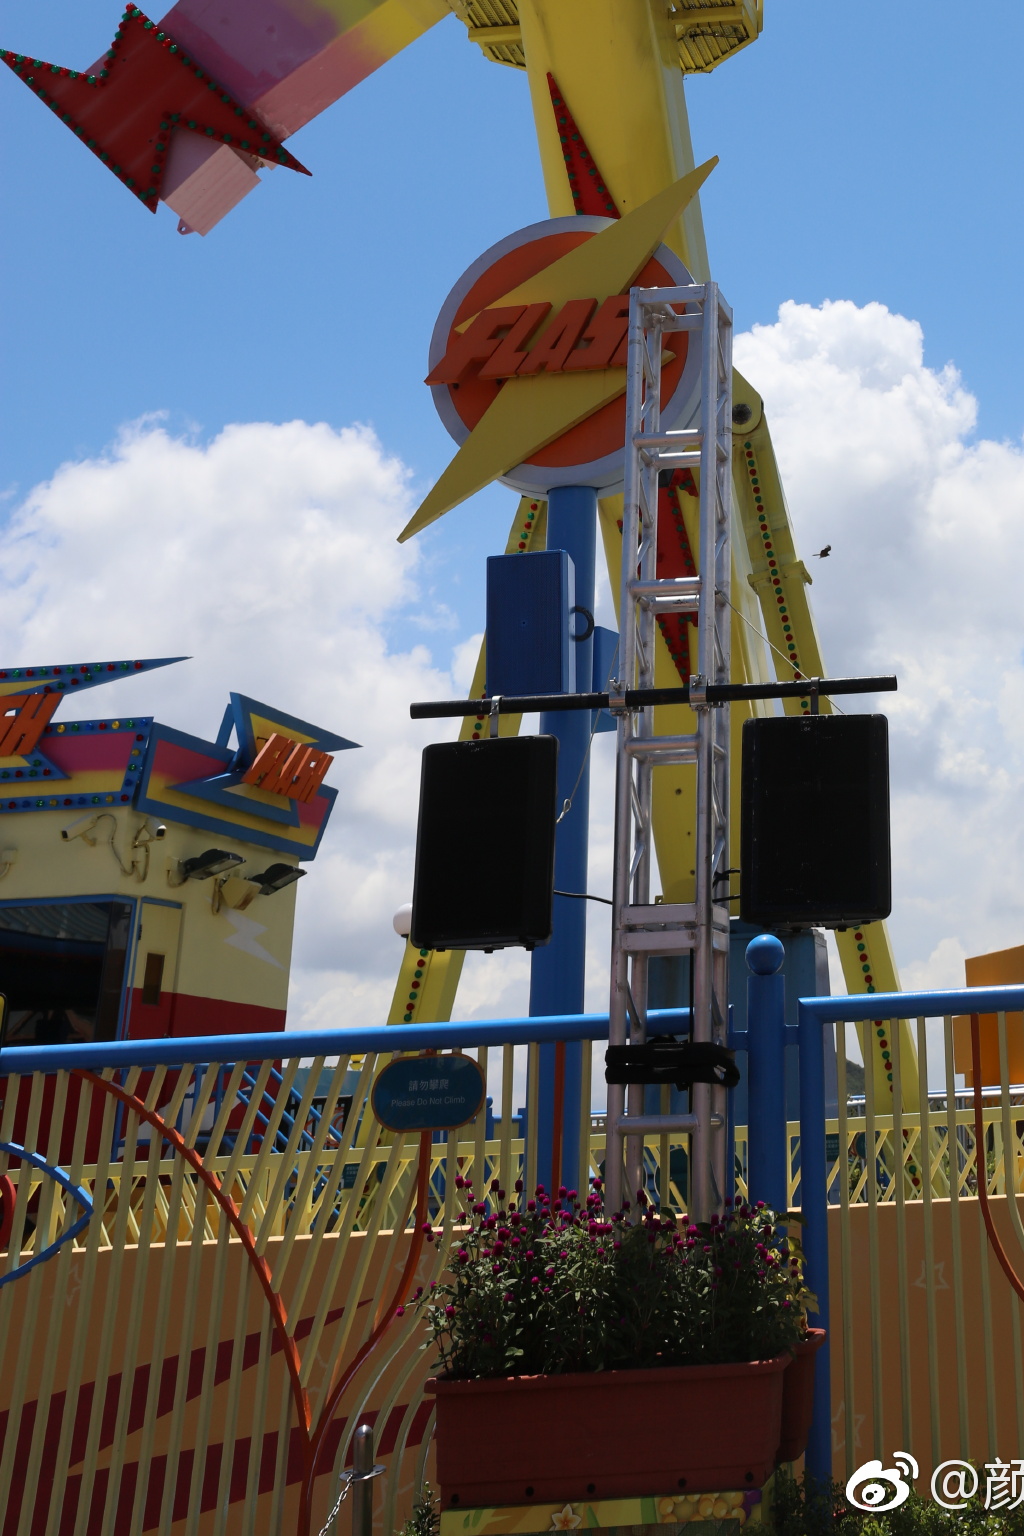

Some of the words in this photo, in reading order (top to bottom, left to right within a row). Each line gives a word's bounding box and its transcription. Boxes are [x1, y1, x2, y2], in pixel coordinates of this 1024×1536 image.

[408, 1078, 449, 1091] 請勿攀爬
[391, 1099, 416, 1107] Please
[417, 1097, 428, 1106] Do
[429, 1097, 442, 1105] Not
[444, 1096, 466, 1105] Climb
